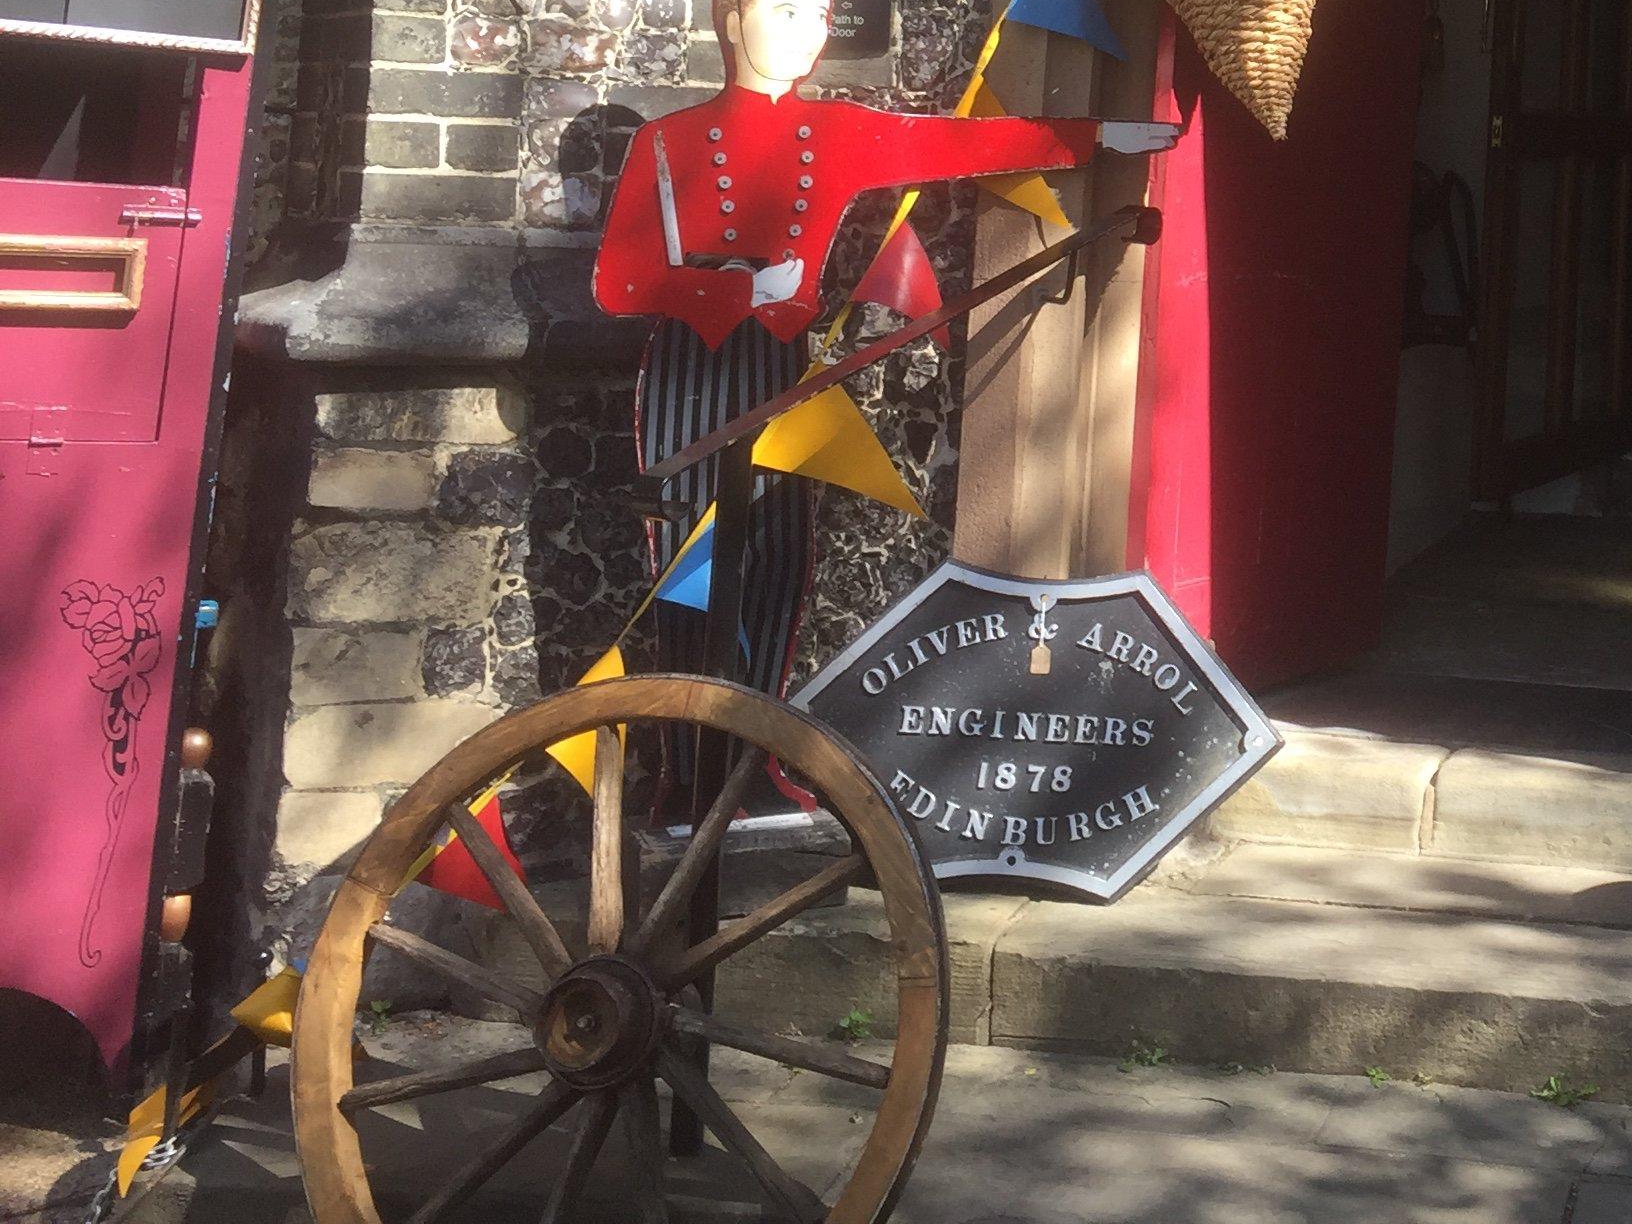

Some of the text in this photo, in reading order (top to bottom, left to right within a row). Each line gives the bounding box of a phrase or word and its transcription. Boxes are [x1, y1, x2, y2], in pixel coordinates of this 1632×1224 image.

[853, 15, 864, 25] to
[860, 611, 1199, 717] OLIVER & ARROL
[898, 704, 1156, 748] ENGINEERS
[976, 760, 1074, 794] 1878
[889, 768, 1161, 847] EDINBURGH
